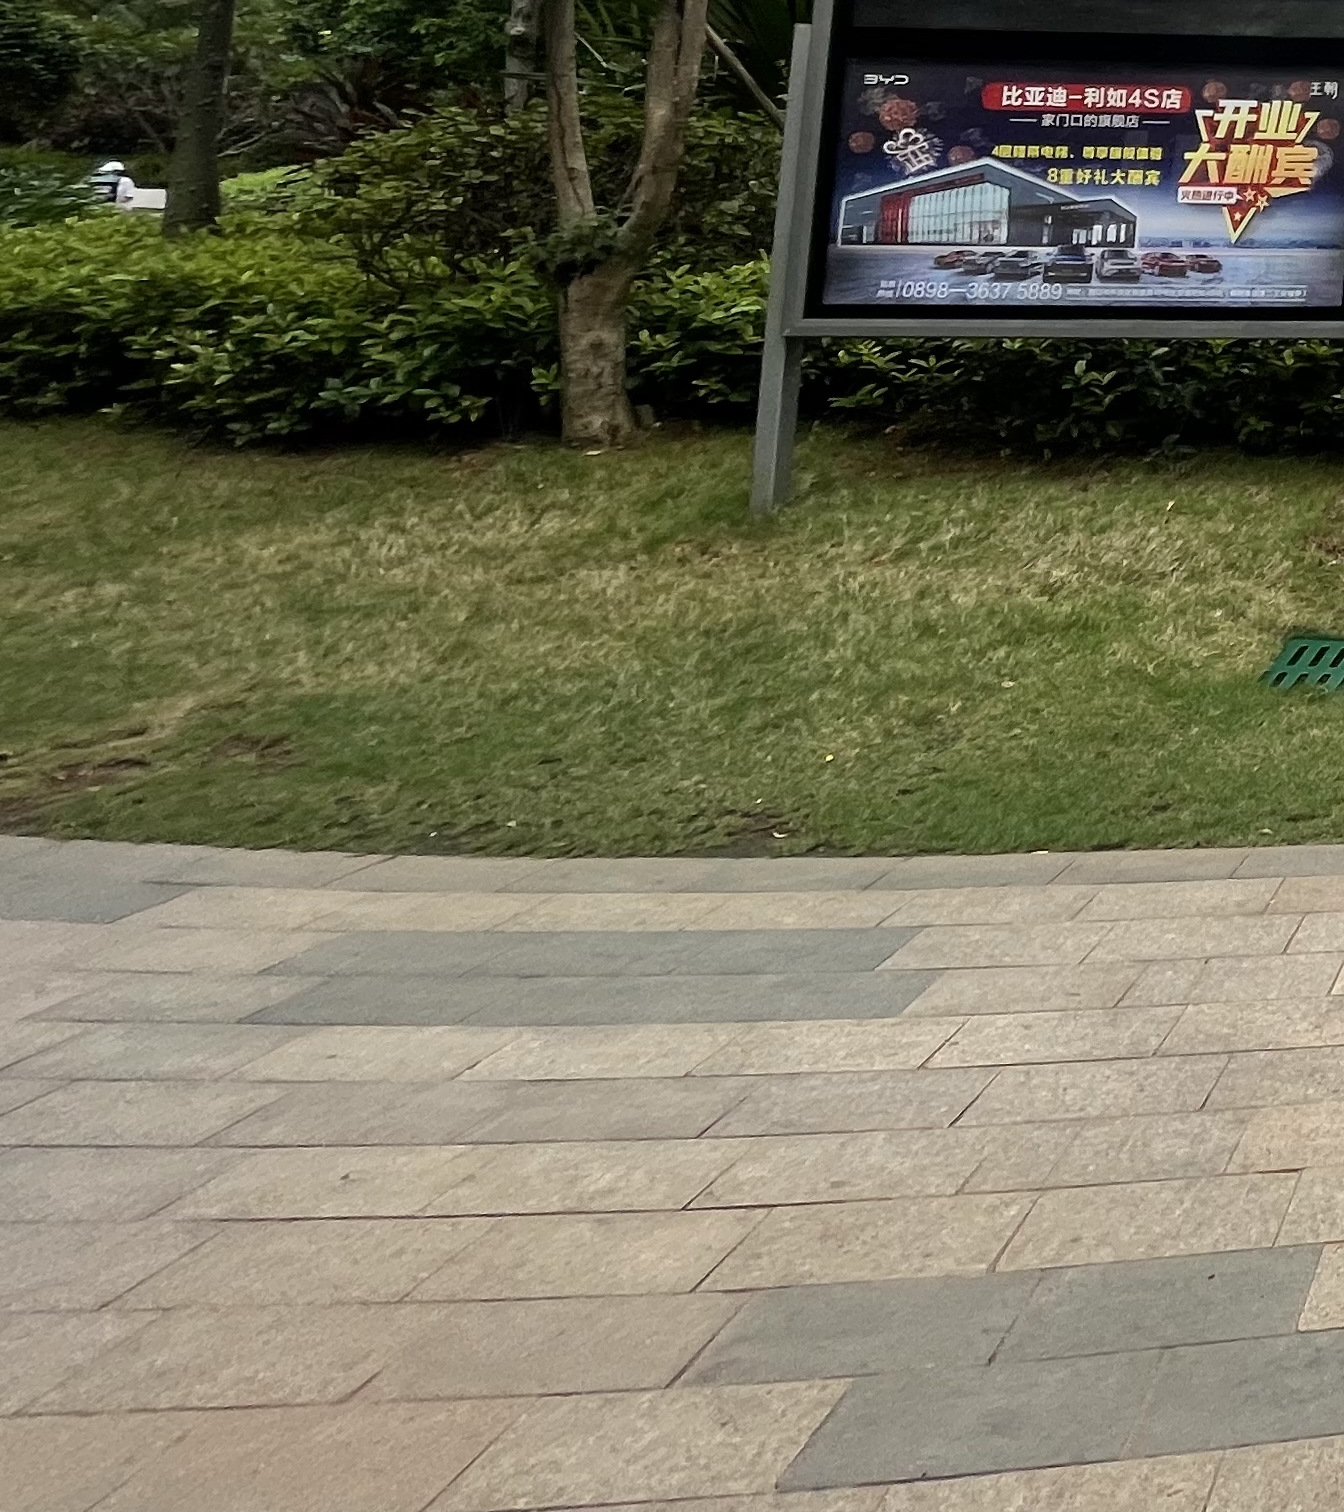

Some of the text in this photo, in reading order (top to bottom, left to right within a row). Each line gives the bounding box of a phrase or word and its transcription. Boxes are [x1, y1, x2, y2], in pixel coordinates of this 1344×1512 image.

[863, 74, 910, 85] BYD
[1309, 80, 1340, 100] 王朝
[1040, 114, 1140, 129] 家门口的旗舰店
[1213, 99, 1302, 141] 开业
[1178, 143, 1319, 185] 大酬宾
[1016, 282, 1063, 300] 5889
